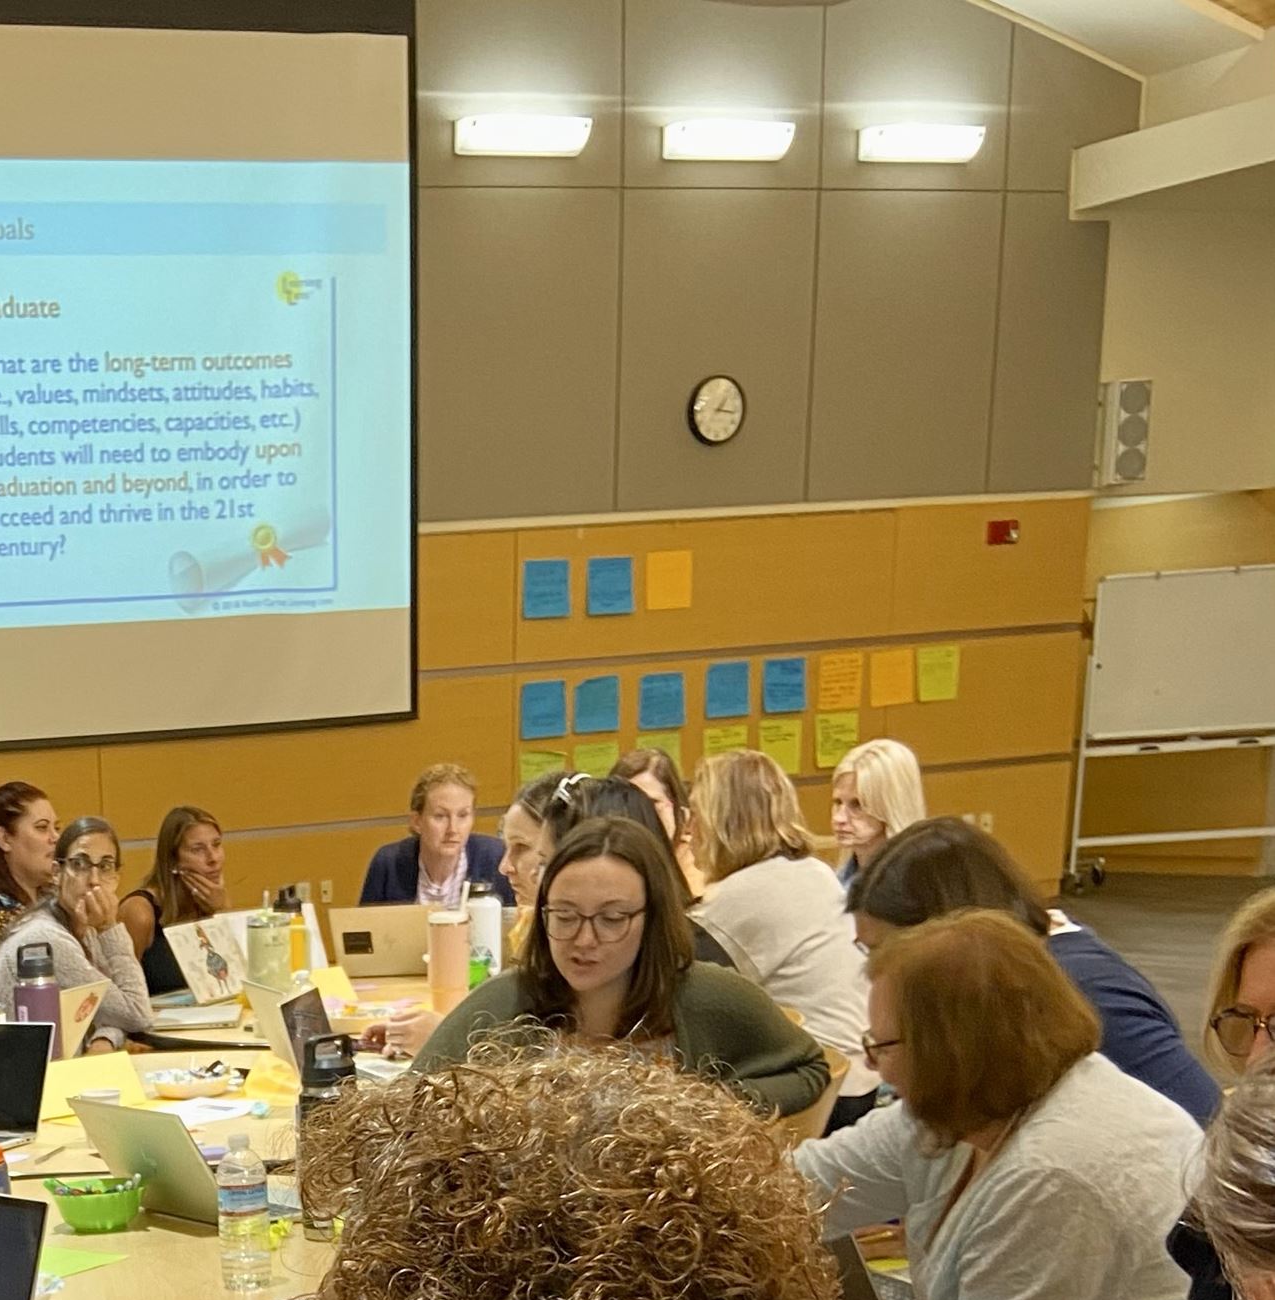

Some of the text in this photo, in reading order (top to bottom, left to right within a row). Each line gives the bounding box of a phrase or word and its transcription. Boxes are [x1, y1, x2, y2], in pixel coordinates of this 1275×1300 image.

[31, 358, 62, 373] are
[68, 352, 98, 373] the
[104, 351, 196, 378] long-term
[201, 352, 292, 371] outcomes
[16, 384, 78, 406] values,
[83, 382, 169, 404] mindsets,
[172, 381, 257, 402] attitudes,
[260, 379, 320, 400] habits,
[28, 413, 161, 440] competencies,
[165, 411, 256, 436] capacities,
[260, 407, 301, 432] etc.)
[63, 444, 93, 464] will
[100, 443, 144, 464] need
[151, 445, 171, 463] to
[177, 440, 250, 465] embody
[256, 441, 302, 463] upon
[83, 473, 115, 494] and
[122, 472, 193, 498] beyond,
[196, 471, 213, 490] in
[218, 469, 271, 489] order
[278, 469, 297, 487] to
[60, 504, 93, 525] and
[100, 503, 152, 524] thrive
[158, 500, 175, 520] in
[180, 499, 210, 520] the
[215, 498, 255, 519] 21st
